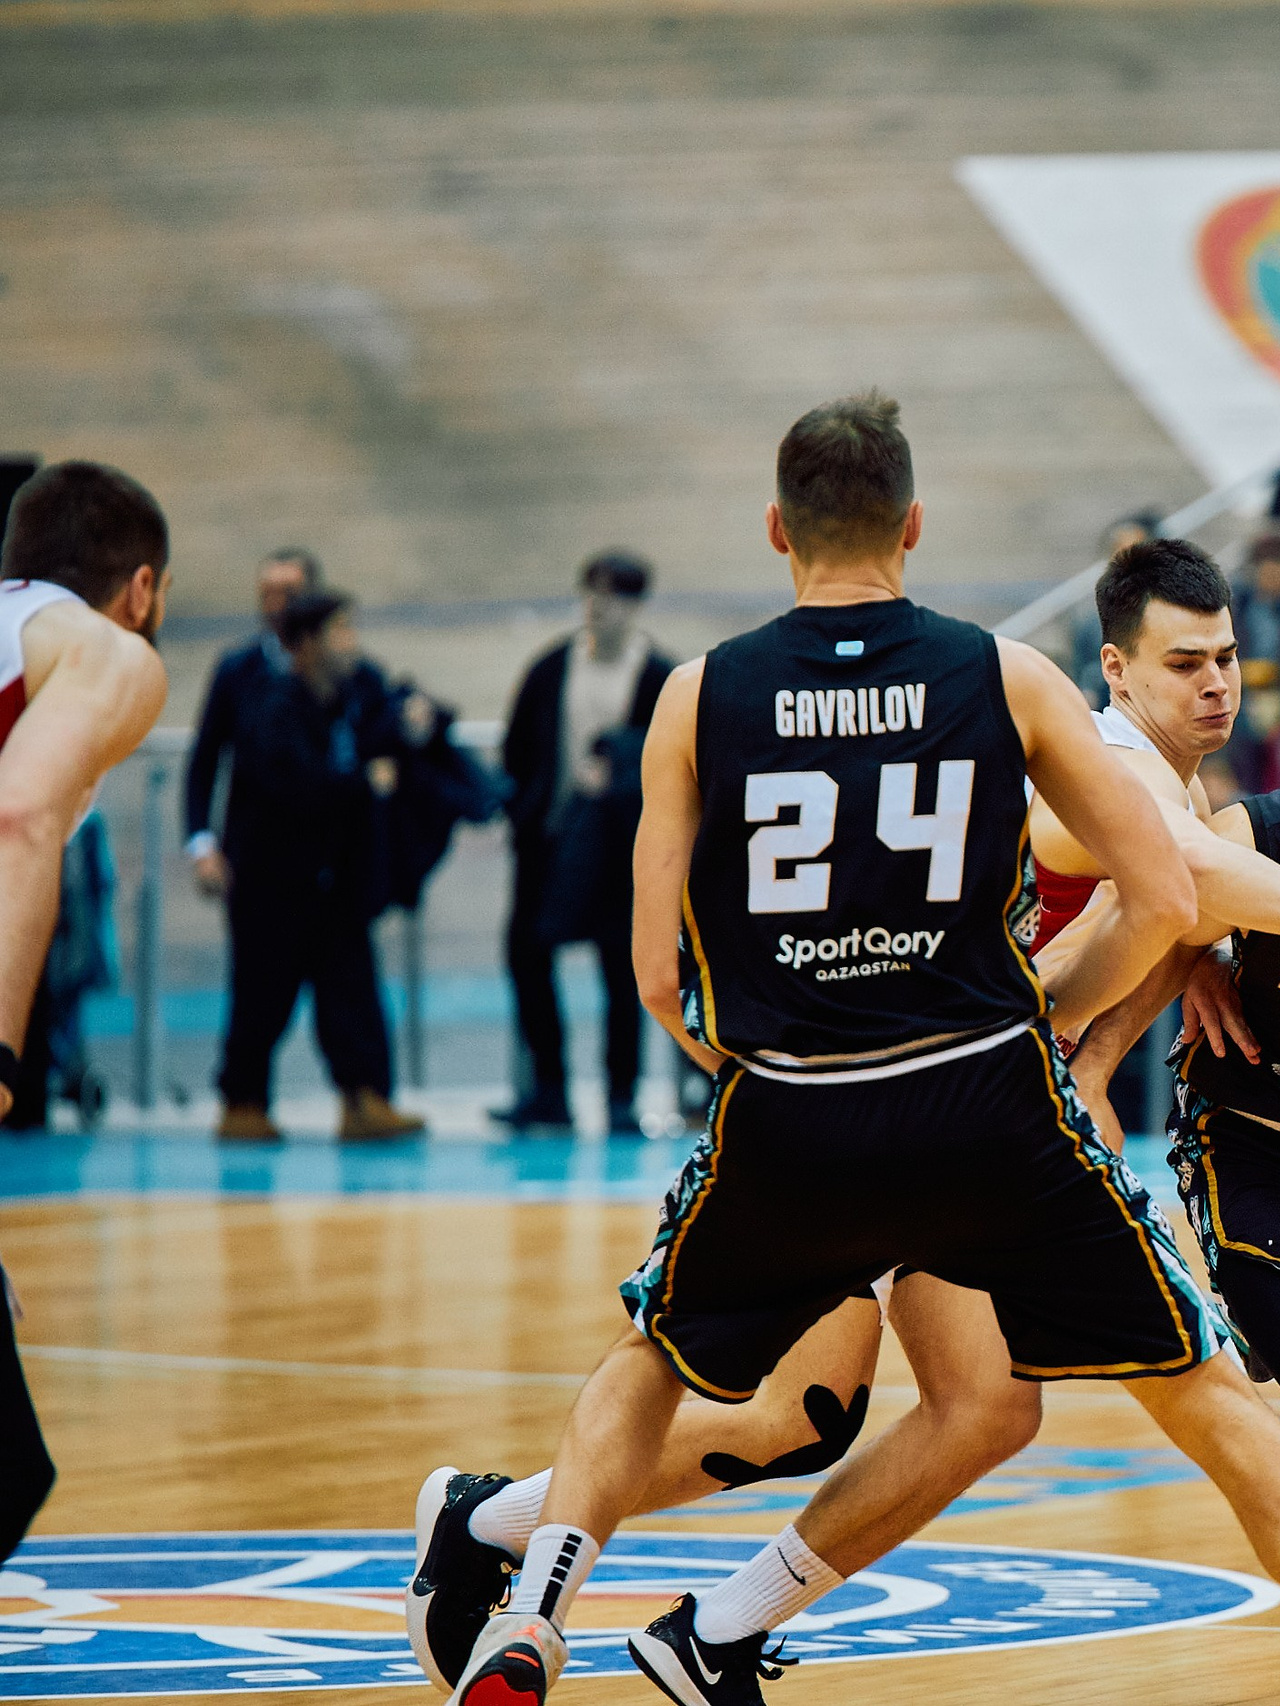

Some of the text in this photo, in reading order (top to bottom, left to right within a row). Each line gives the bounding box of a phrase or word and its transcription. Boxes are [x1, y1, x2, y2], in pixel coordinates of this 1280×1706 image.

[775, 682, 926, 738] GAVRILOV
[744, 758, 975, 915] 24
[775, 926, 945, 970] SportQory
[815, 960, 911, 982] QAZAQSTAN
